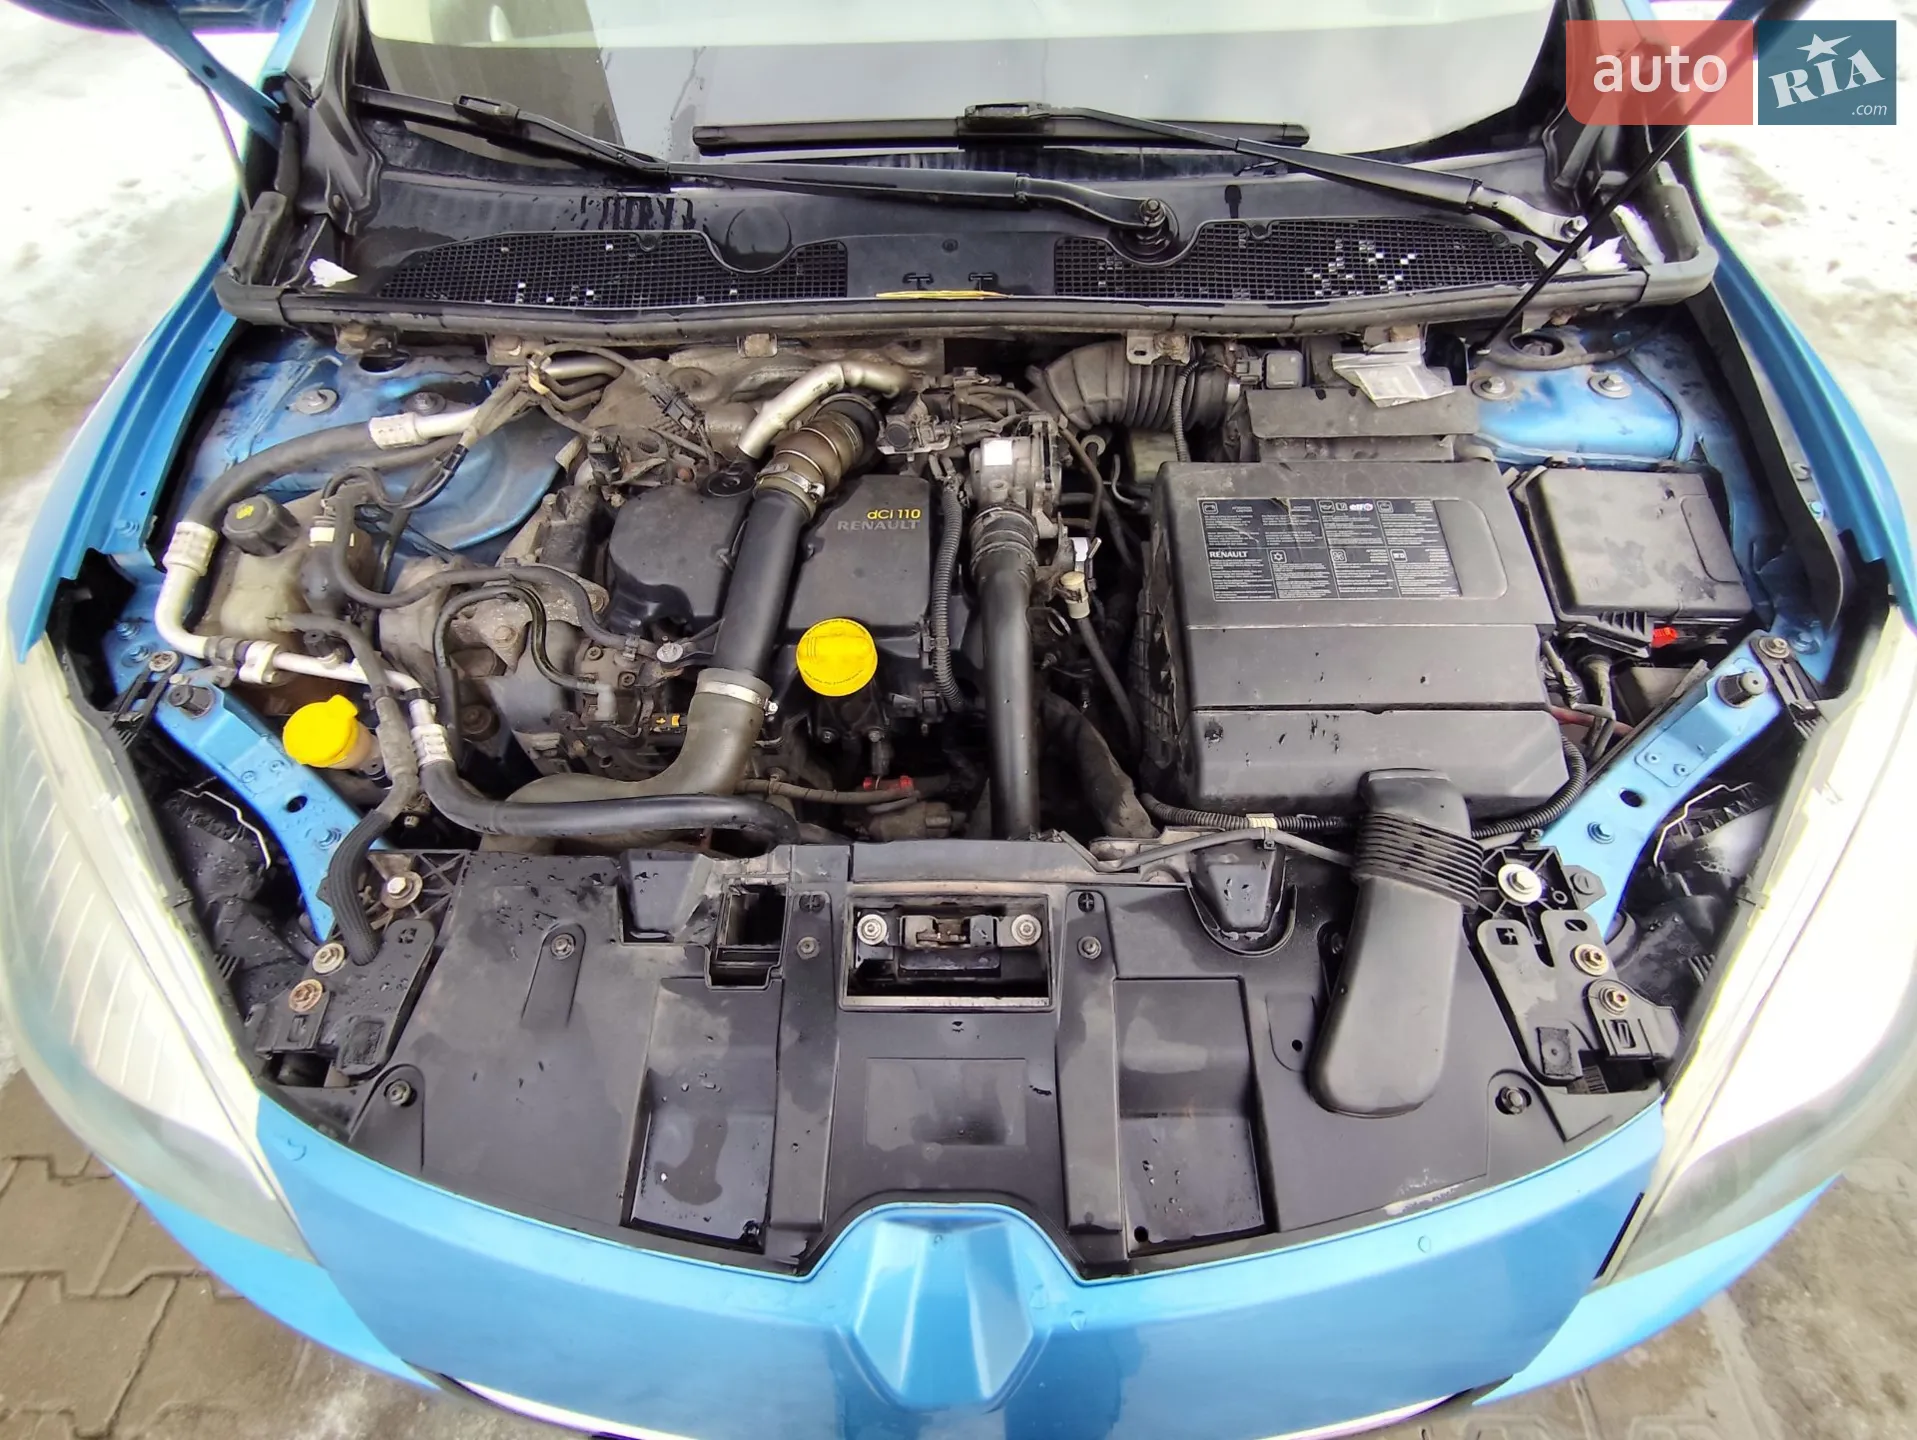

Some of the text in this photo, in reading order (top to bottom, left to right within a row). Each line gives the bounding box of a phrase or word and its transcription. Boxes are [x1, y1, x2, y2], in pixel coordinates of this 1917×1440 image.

[897, 508, 921, 519] 110
[837, 519, 920, 531] RENAULT
[1209, 550, 1249, 558] RENAULT
